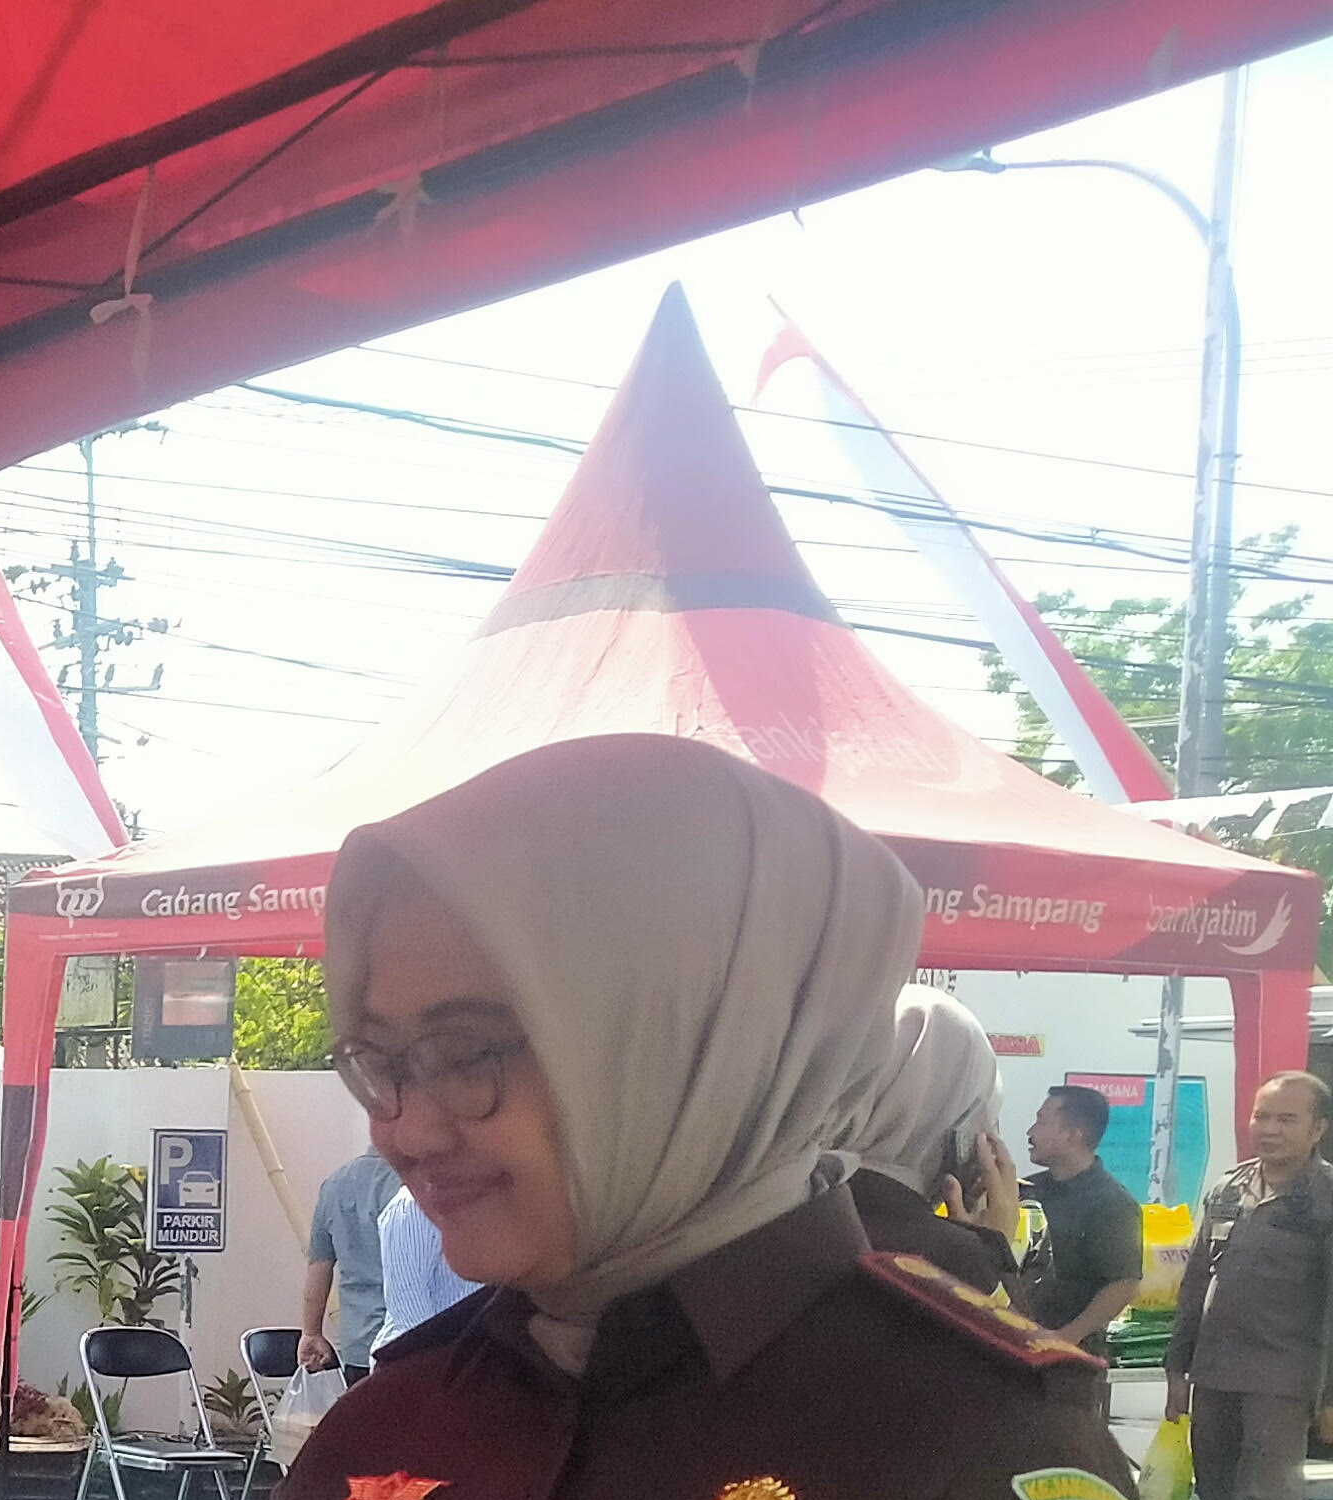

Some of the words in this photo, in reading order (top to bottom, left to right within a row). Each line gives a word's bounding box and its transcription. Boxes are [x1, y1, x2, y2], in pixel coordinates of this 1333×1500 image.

[141, 886, 241, 921] Cabang
[969, 883, 1107, 933] Sampang
[1146, 893, 1257, 945] bankjatim
[160, 1136, 193, 1185] P
[157, 1229, 220, 1243] MUNDUR
[163, 1214, 215, 1229] PARKIR
